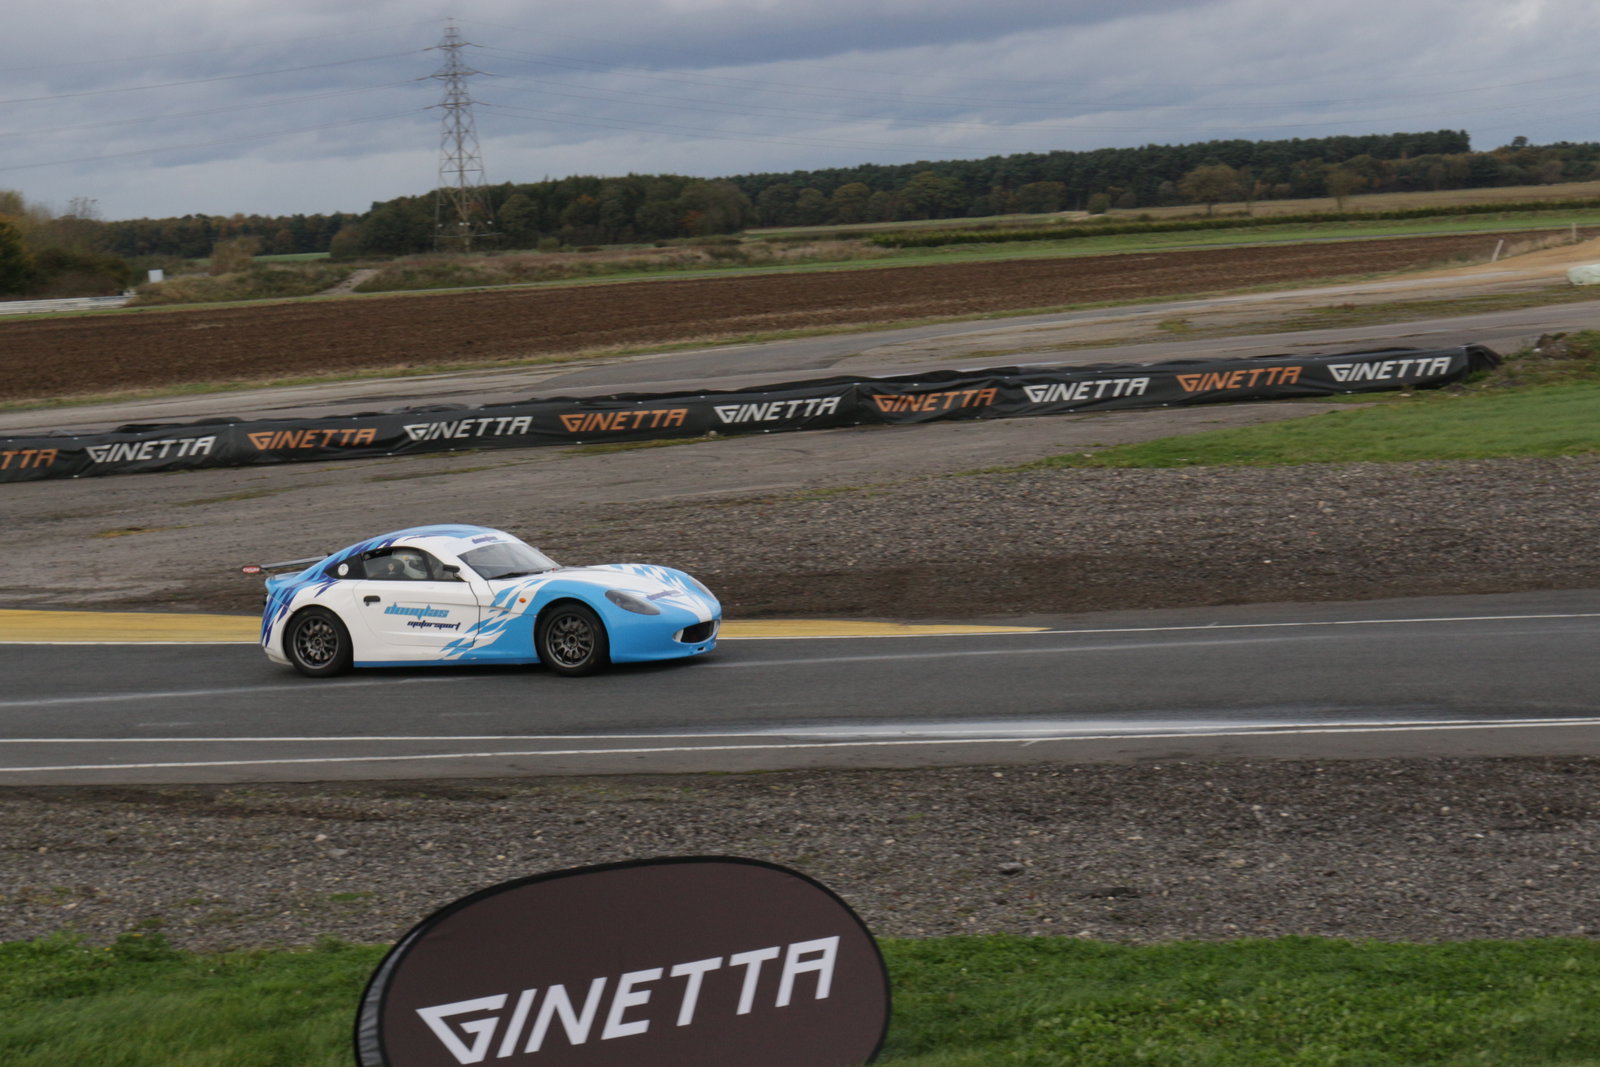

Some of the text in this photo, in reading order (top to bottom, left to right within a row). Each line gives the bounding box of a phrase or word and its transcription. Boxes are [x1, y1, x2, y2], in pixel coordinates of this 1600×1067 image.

[1176, 366, 1303, 393] GINETTA
[1328, 356, 1452, 383] GINETTA
[872, 387, 998, 413] GINETTA
[1022, 377, 1150, 404] GINETTA
[560, 408, 688, 434] GINETTA
[714, 396, 841, 425] GINETTA
[248, 427, 377, 450] GINETTA
[402, 415, 533, 442] GINETTA
[86, 436, 217, 463] GINETTA
[407, 620, 461, 631] motorsport
[416, 936, 840, 1065] GINETTA
